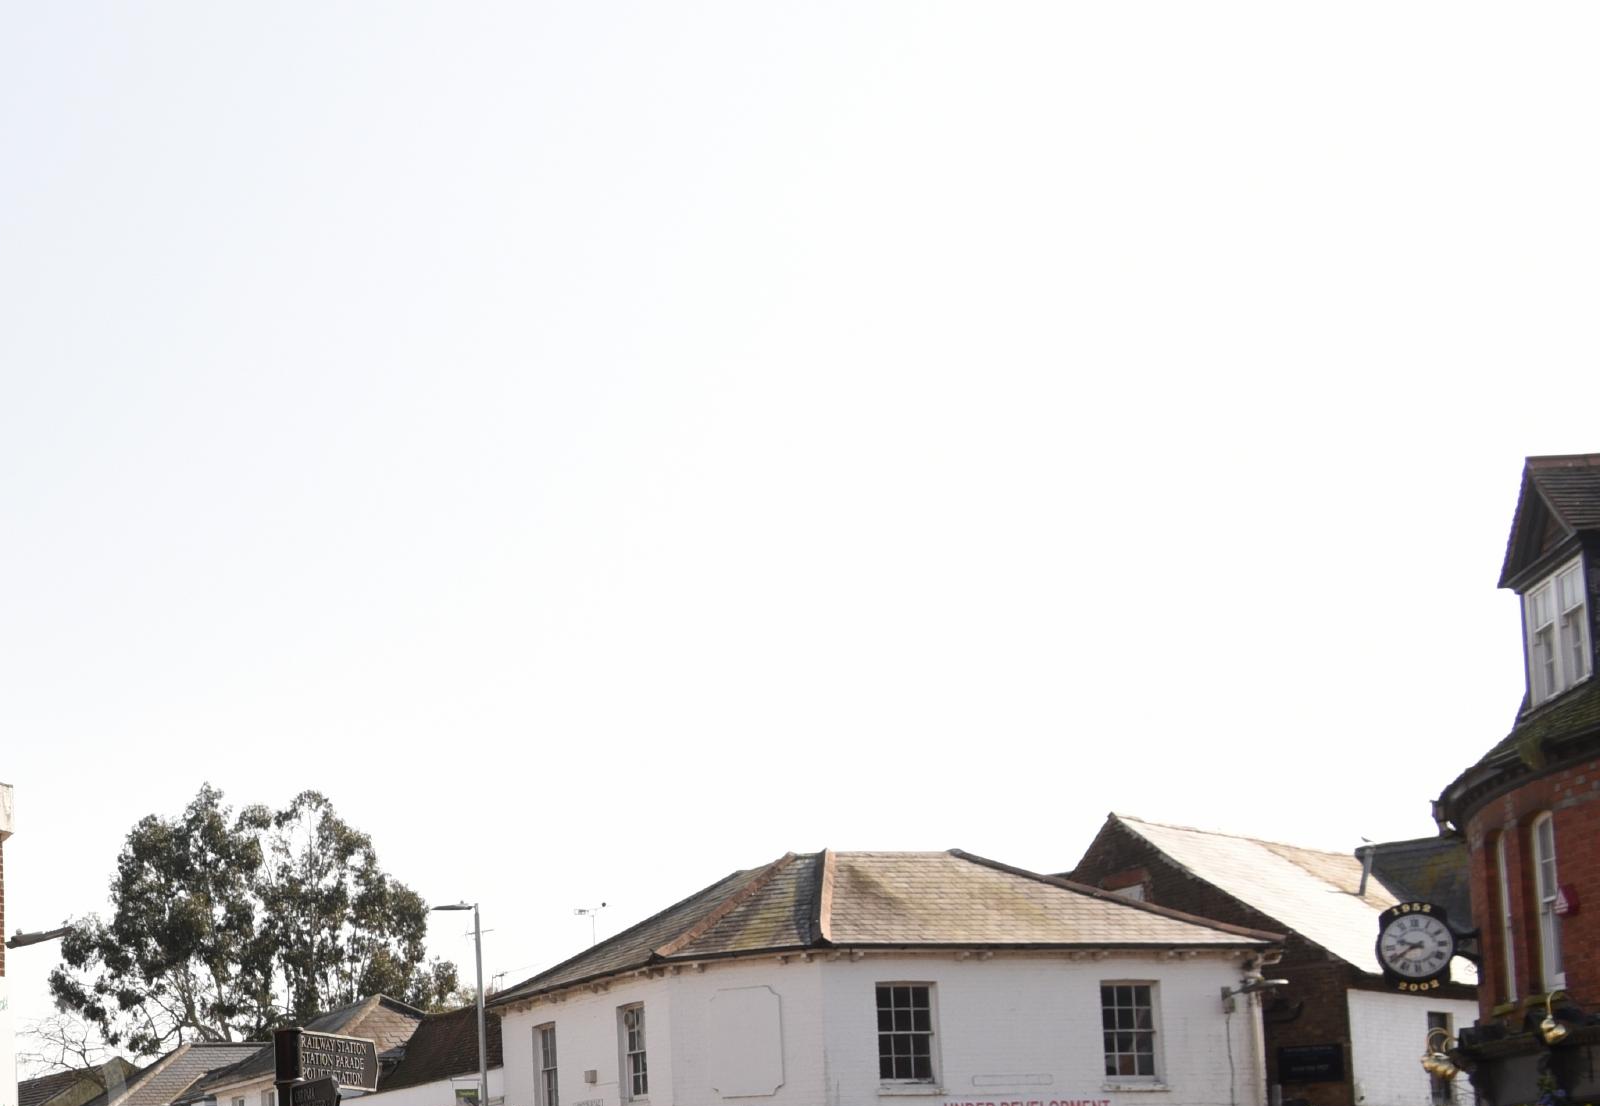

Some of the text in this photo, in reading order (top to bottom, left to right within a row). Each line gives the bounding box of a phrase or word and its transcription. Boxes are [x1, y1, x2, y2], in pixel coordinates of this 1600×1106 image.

[1392, 903, 1431, 915] 1952
[1398, 979, 1440, 991] 2002
[301, 1035, 367, 1055] RAILWAY STATION
[301, 1051, 365, 1070] STATION PARADE
